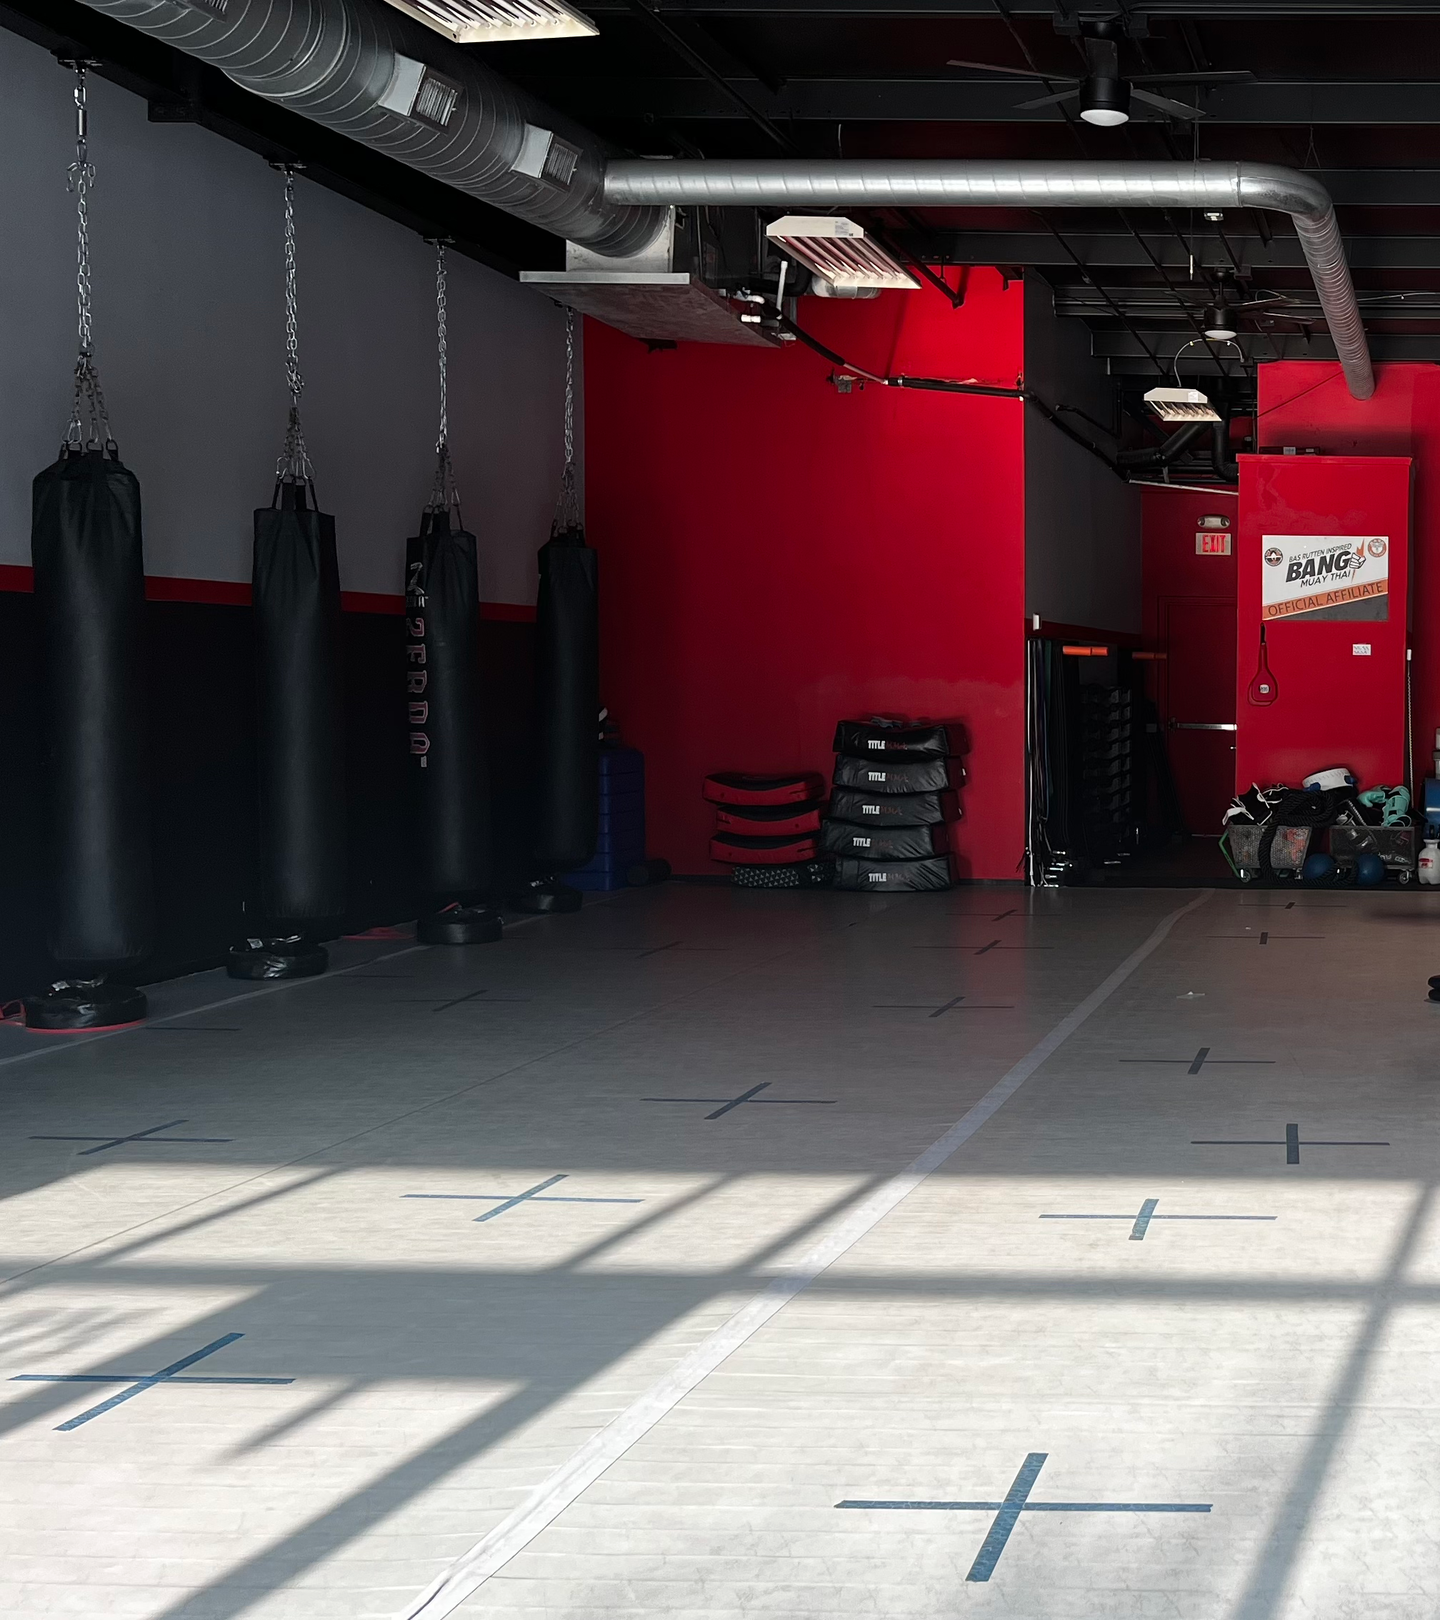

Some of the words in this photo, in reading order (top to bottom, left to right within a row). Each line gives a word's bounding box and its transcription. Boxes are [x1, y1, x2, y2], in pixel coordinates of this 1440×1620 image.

[1202, 534, 1226, 552] EXIT
[1288, 554, 1301, 562] BAS
[1302, 549, 1325, 559] RUTTEN
[1325, 543, 1352, 555] INSPIRED
[1285, 550, 1352, 583] BANG
[1300, 575, 1328, 588] MUAY
[1330, 570, 1351, 582] THAI
[1268, 596, 1323, 617] OFFICIAL
[1325, 582, 1383, 607] AFFILIATE
[867, 740, 886, 750] TITLE
[868, 772, 886, 782] TITLE
[862, 805, 880, 815] TITLE
[853, 837, 871, 847] TITLE
[868, 873, 887, 882] TITLE
